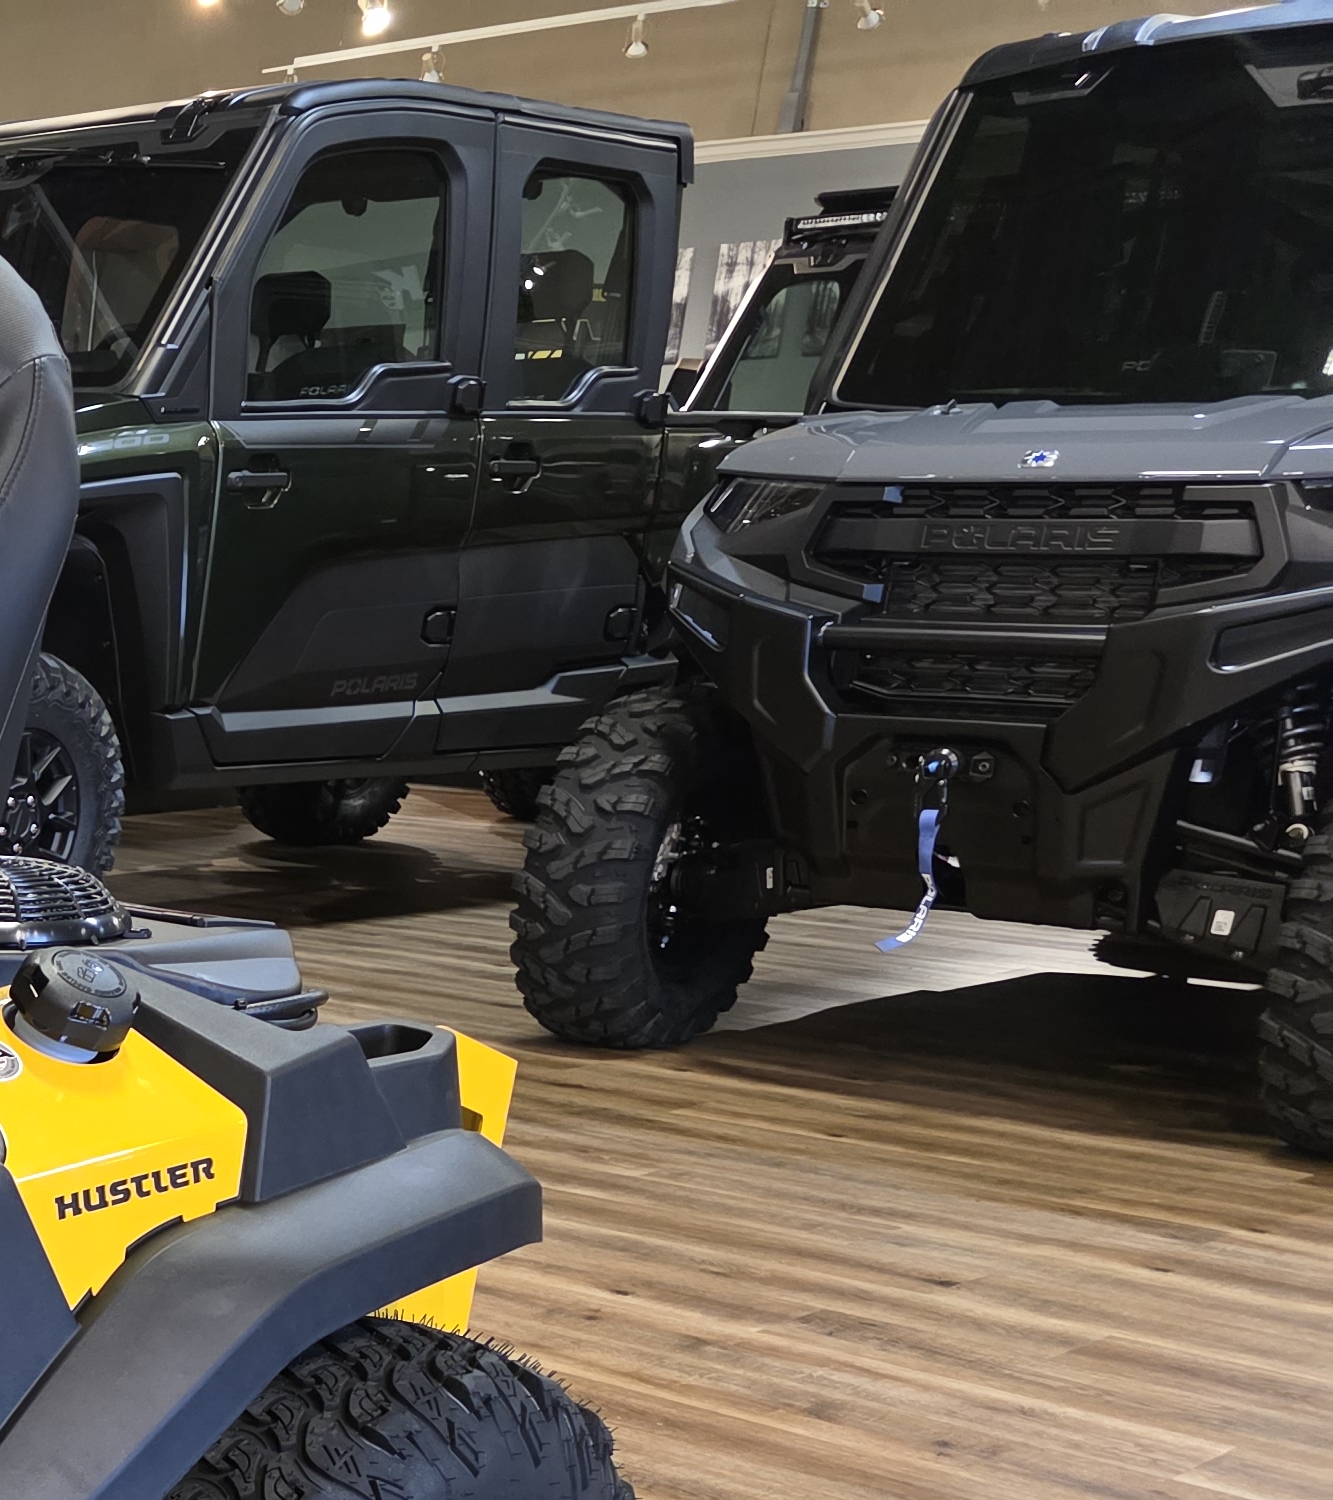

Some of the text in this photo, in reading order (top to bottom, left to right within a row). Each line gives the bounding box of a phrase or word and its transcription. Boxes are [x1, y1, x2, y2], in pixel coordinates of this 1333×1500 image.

[921, 525, 1120, 550] POLARIS
[330, 672, 418, 697] POLARIS
[55, 1157, 215, 1220] HUSTLER
